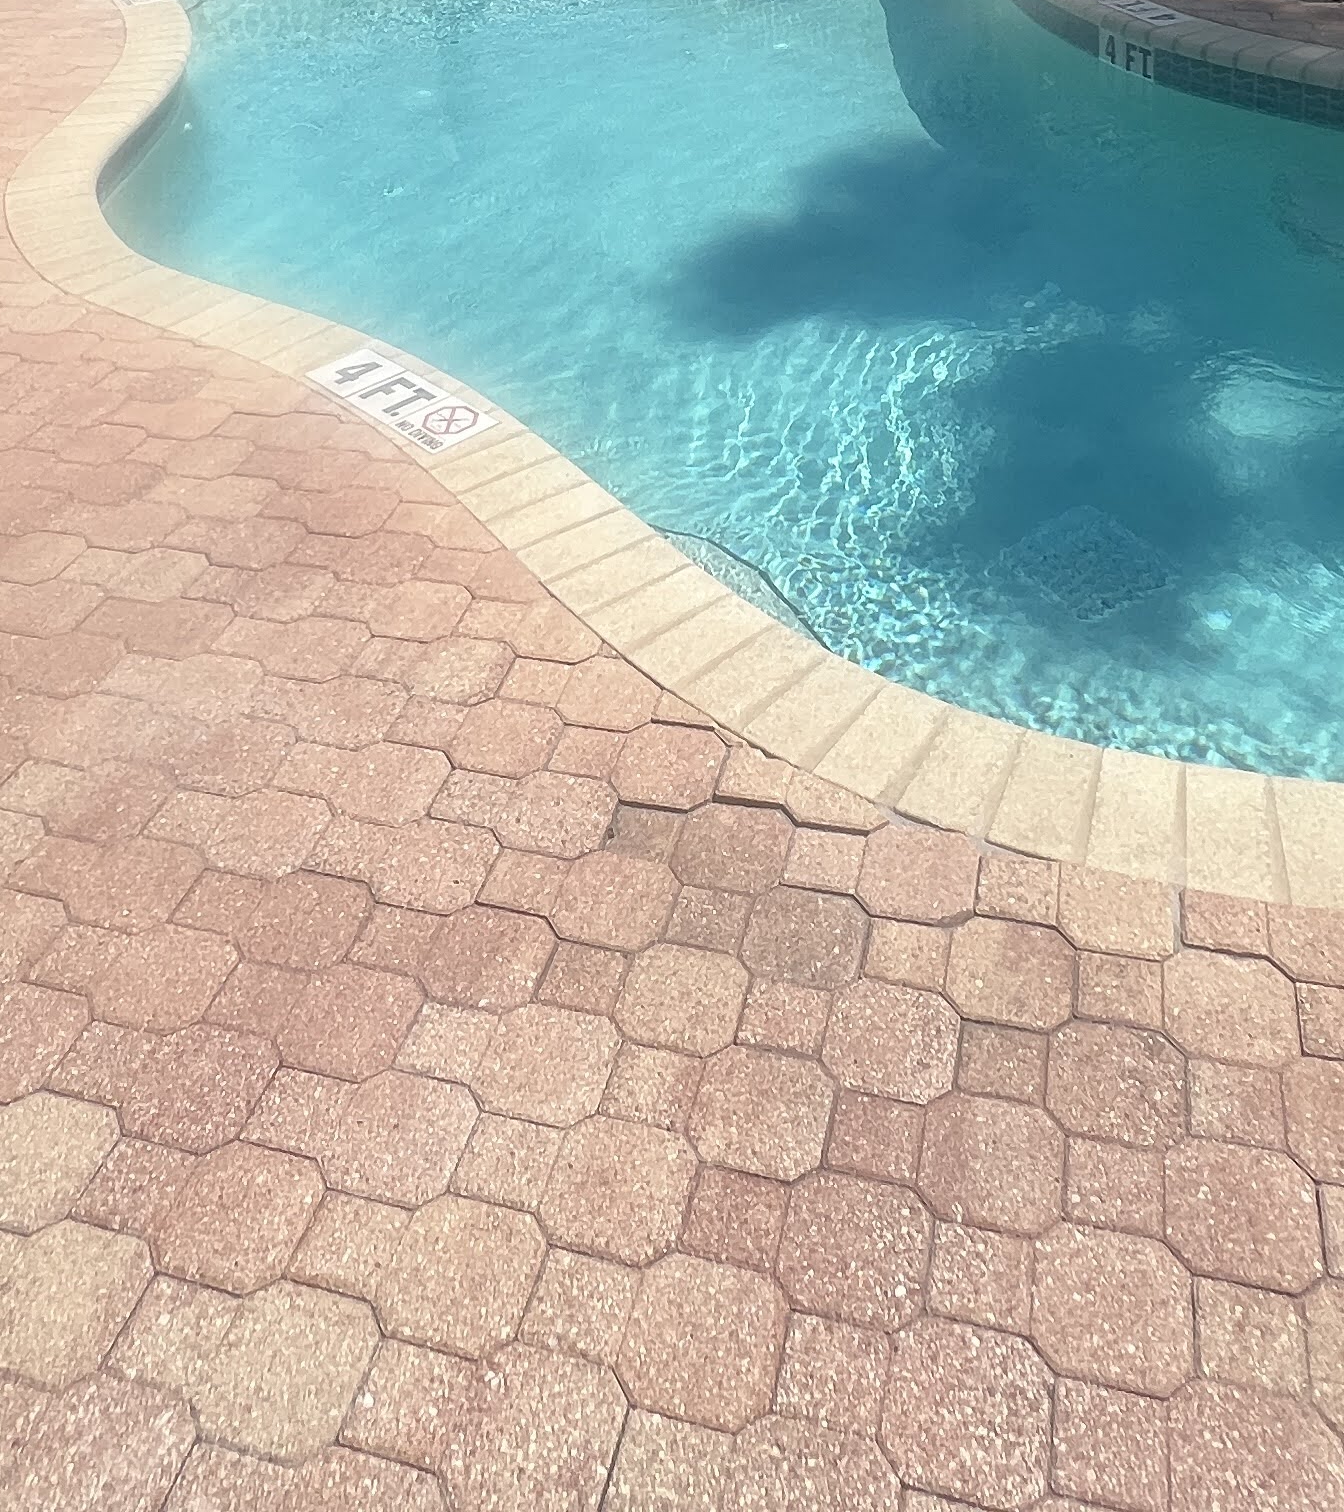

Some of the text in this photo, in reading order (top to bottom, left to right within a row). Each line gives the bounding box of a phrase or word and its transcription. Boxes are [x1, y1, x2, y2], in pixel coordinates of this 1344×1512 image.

[1105, 34, 1116, 65] 4
[334, 361, 383, 385] 4
[394, 420, 443, 450] NO DIVING
